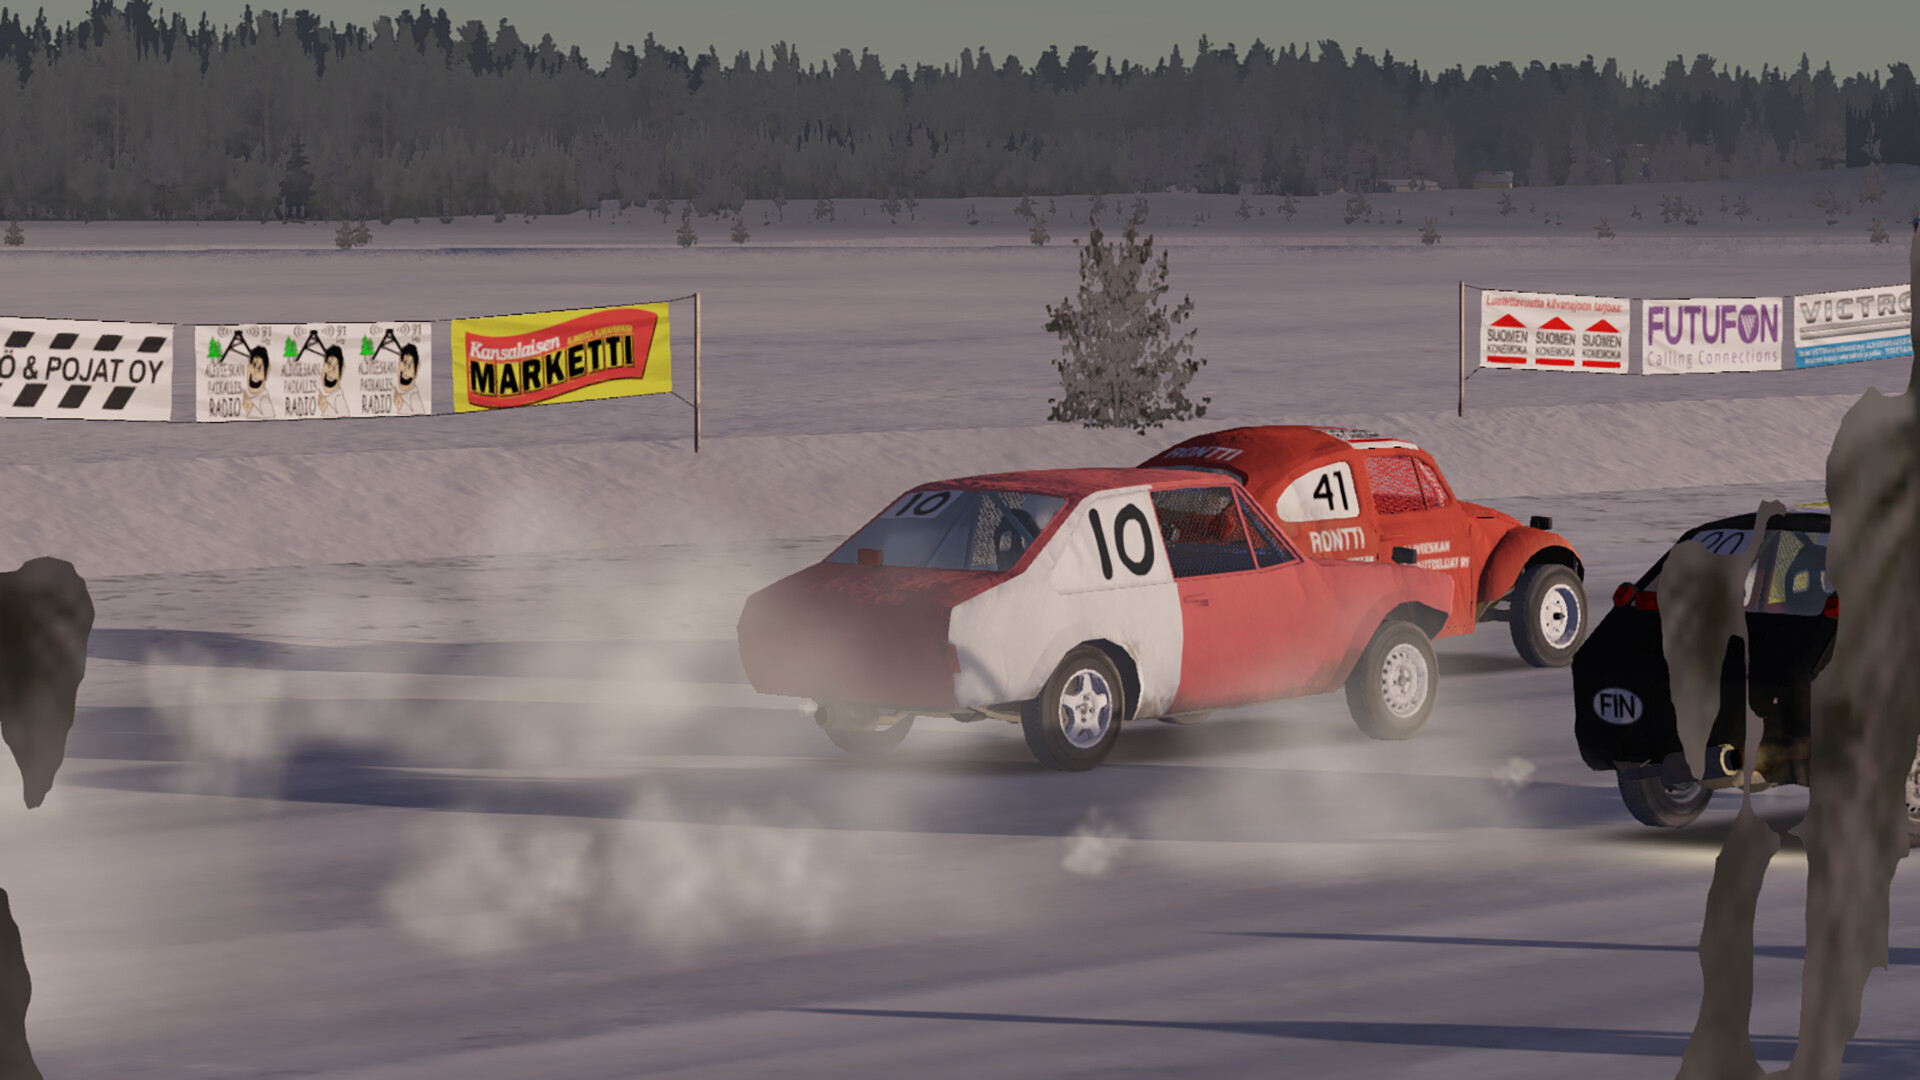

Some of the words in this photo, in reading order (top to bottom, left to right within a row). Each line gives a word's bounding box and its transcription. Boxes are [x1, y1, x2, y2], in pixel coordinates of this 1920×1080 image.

[1487, 328, 1528, 344] SUOMEN
[1648, 304, 1778, 346] FUTUFON
[470, 336, 560, 361] Kansalaisen
[1536, 331, 1576, 346] SUOMEN
[1582, 333, 1621, 348] SUOMEN
[23, 355, 38, 380] &
[46, 356, 124, 383] POJAT
[129, 359, 163, 384] OY
[470, 334, 633, 395] MARKETTI
[1647, 350, 1693, 369] Calling
[1698, 349, 1778, 365] Connections
[209, 397, 242, 418] RADIO
[285, 396, 317, 417] RADIO
[361, 394, 393, 415] RADIO
[1164, 446, 1243, 461] RONTTI
[1313, 470, 1348, 511] 41
[895, 491, 951, 516] 10
[1089, 503, 1154, 580] 10
[1309, 526, 1365, 553] RONTTI
[1600, 693, 1635, 718] FIN
